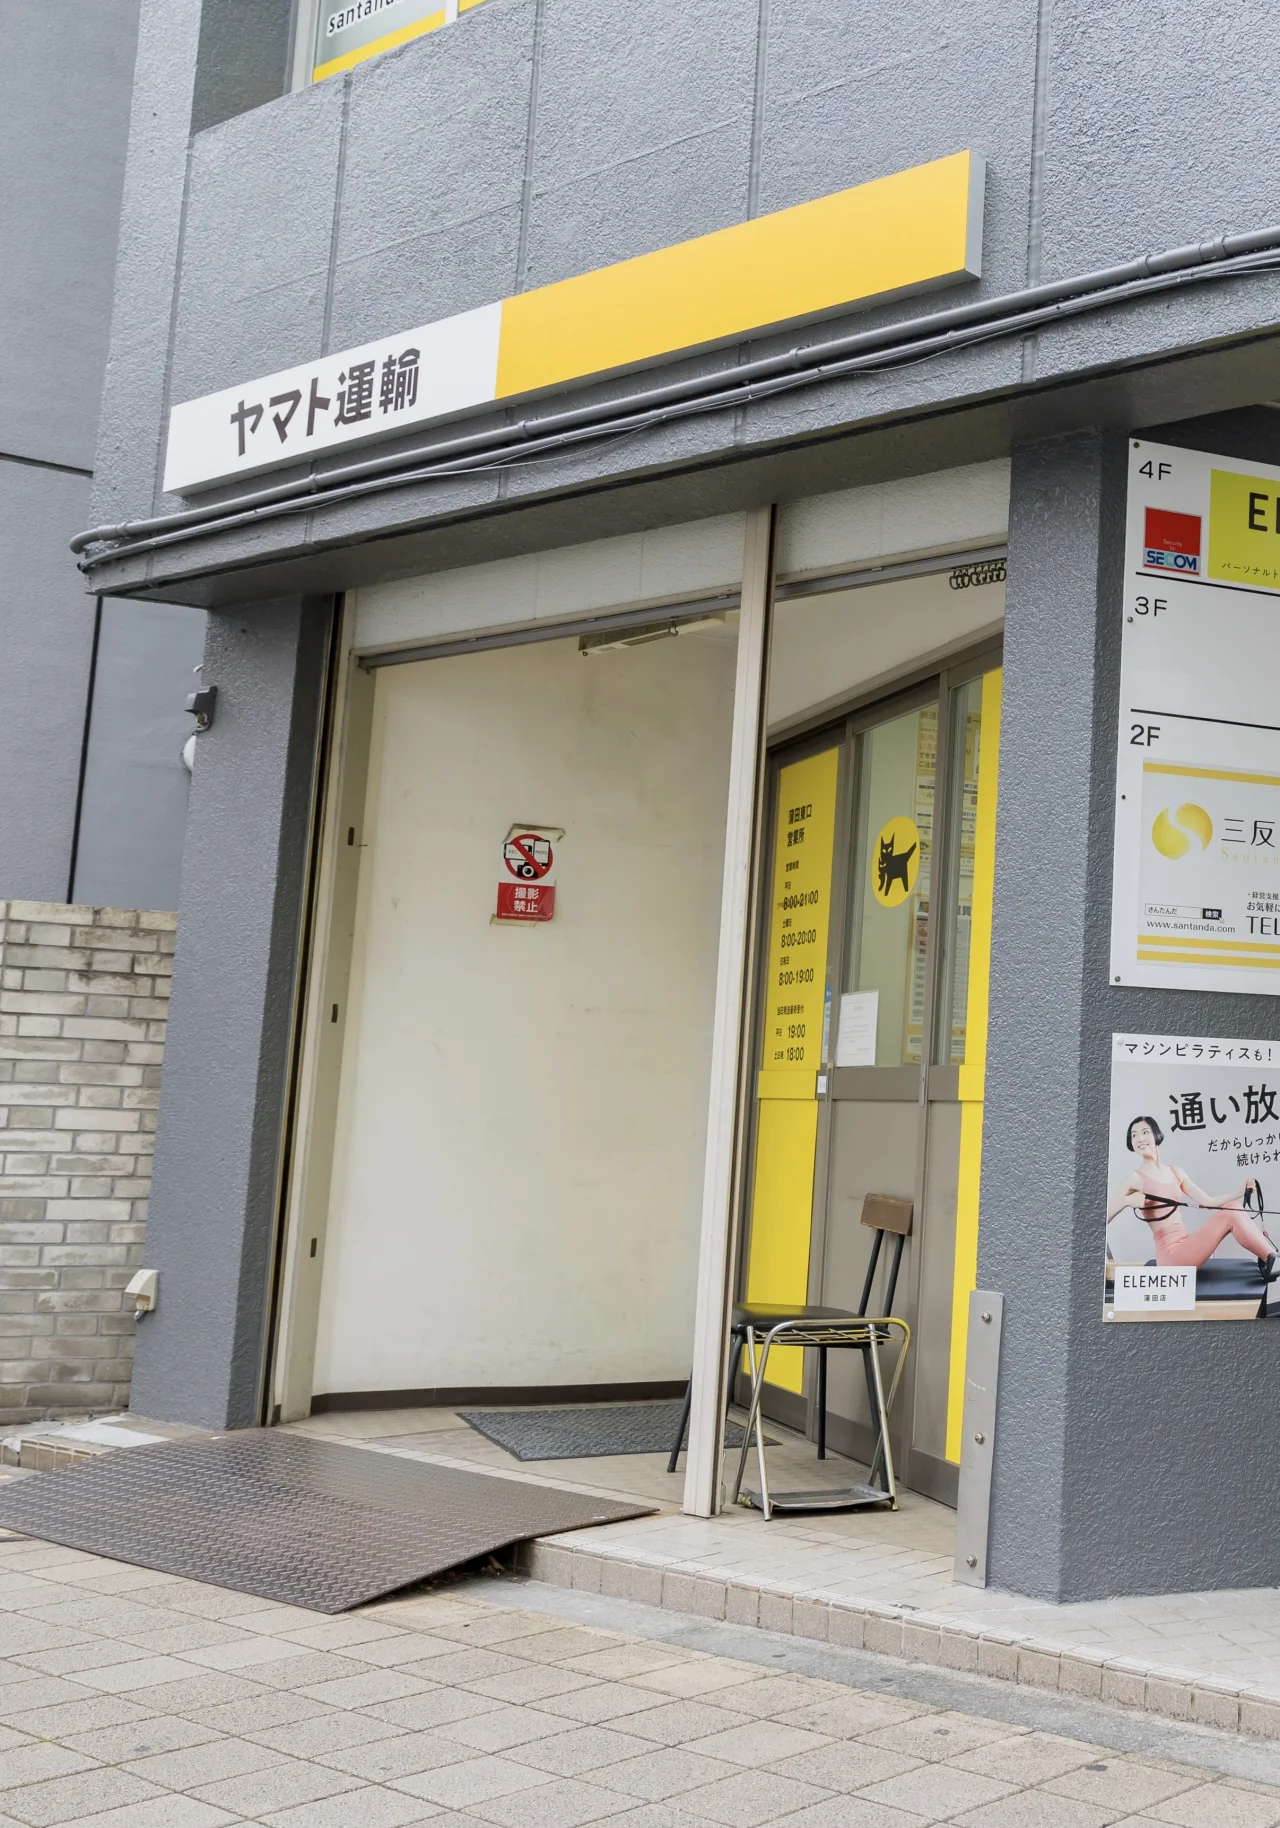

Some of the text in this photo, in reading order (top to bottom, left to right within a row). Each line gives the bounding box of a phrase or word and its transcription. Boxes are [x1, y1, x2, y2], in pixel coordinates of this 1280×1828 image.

[328, 0, 394, 33] santan
[229, 347, 422, 457] ヤマト運輸
[1139, 460, 1172, 481] 4F
[1146, 550, 1197, 571] SECOM
[1134, 596, 1168, 617] 3F
[1129, 724, 1161, 747] 2F
[787, 827, 805, 848] 営業所
[514, 886, 539, 900] 撮影
[783, 889, 819, 910] 8:00-21:00
[513, 900, 538, 913] 禁止
[1148, 906, 1178, 915] さんたんだ
[1146, 921, 1236, 933] www.santanda.com
[781, 929, 816, 948] 8:00-20:00
[778, 968, 814, 986] 8:00-19:00
[788, 1024, 806, 1039] 19:00
[786, 1047, 805, 1061] 18:00
[1124, 1041, 1273, 1062] マシンピラティスも!
[1123, 1273, 1187, 1289] ELEMENT
[1143, 1293, 1167, 1303] 蒲田店
